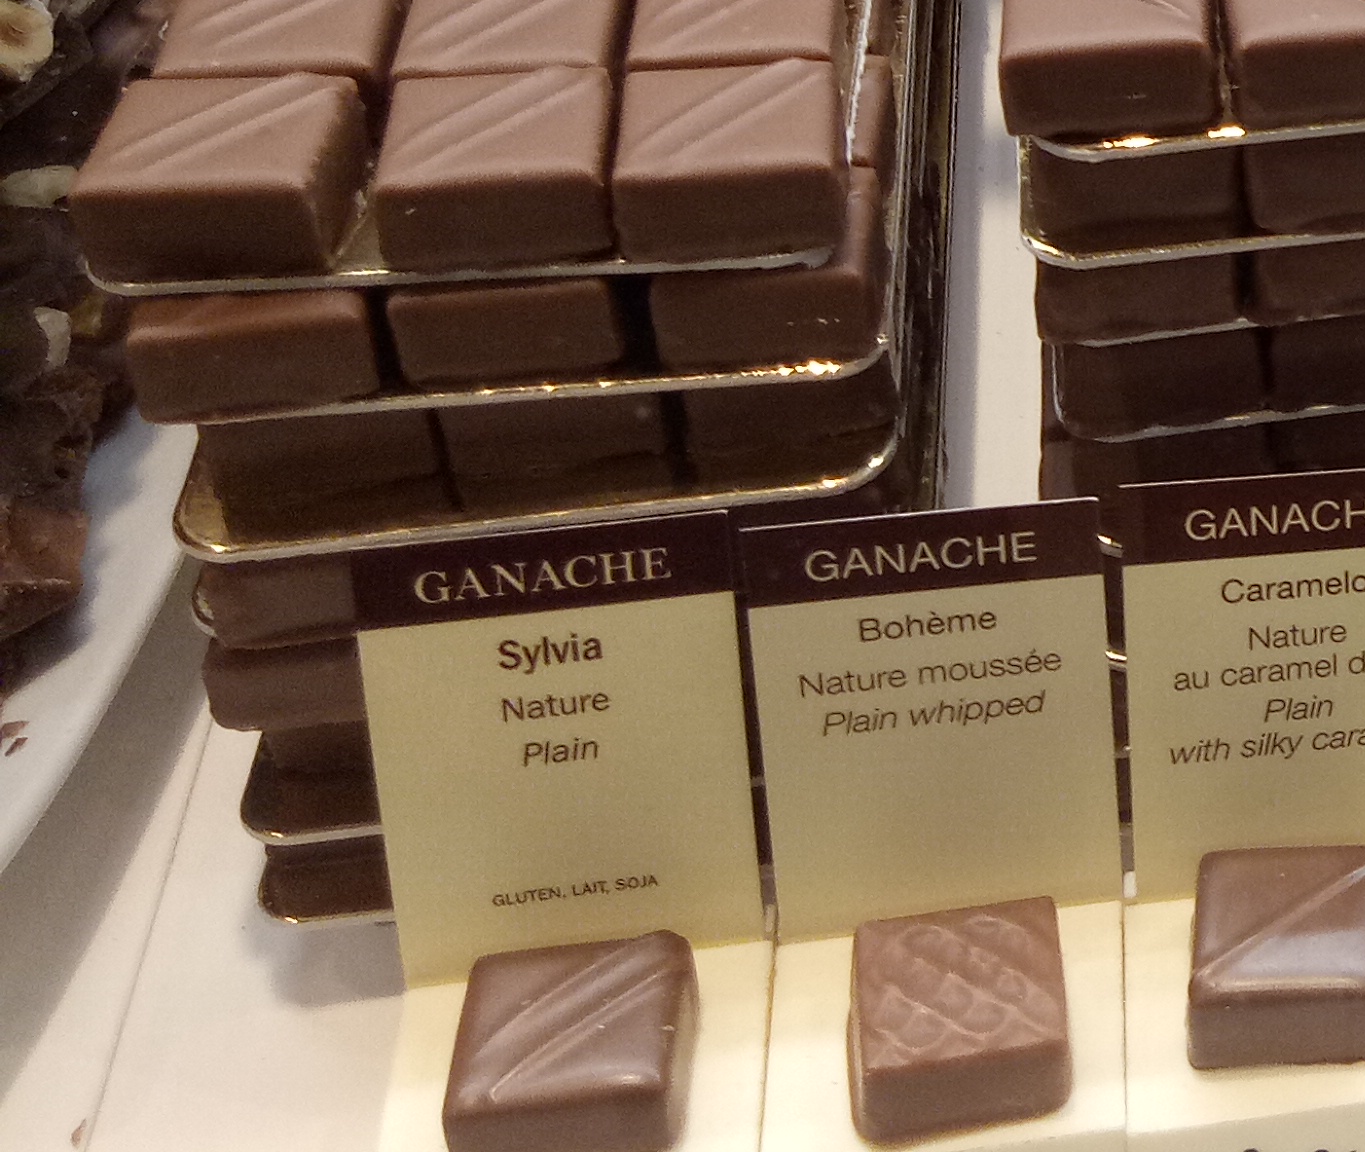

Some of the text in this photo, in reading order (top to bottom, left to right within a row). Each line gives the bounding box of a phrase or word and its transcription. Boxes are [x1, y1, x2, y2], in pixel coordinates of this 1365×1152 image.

[804, 531, 1038, 582] GANACHE
[414, 548, 672, 603] GANACHE
[858, 610, 997, 643] Bohème
[1249, 623, 1347, 651] Nature
[497, 632, 603, 675] Sylvia
[798, 649, 1063, 698] Nature moussée
[1174, 670, 1210, 692] au
[1220, 654, 1338, 687] caramel
[501, 692, 611, 723] Nature
[822, 690, 1046, 737] Plain whipped
[1263, 694, 1334, 724] Plain
[522, 737, 599, 767] Plain
[1170, 737, 1231, 766] with
[1240, 732, 1304, 759] silky
[615, 874, 659, 892] SOJA
